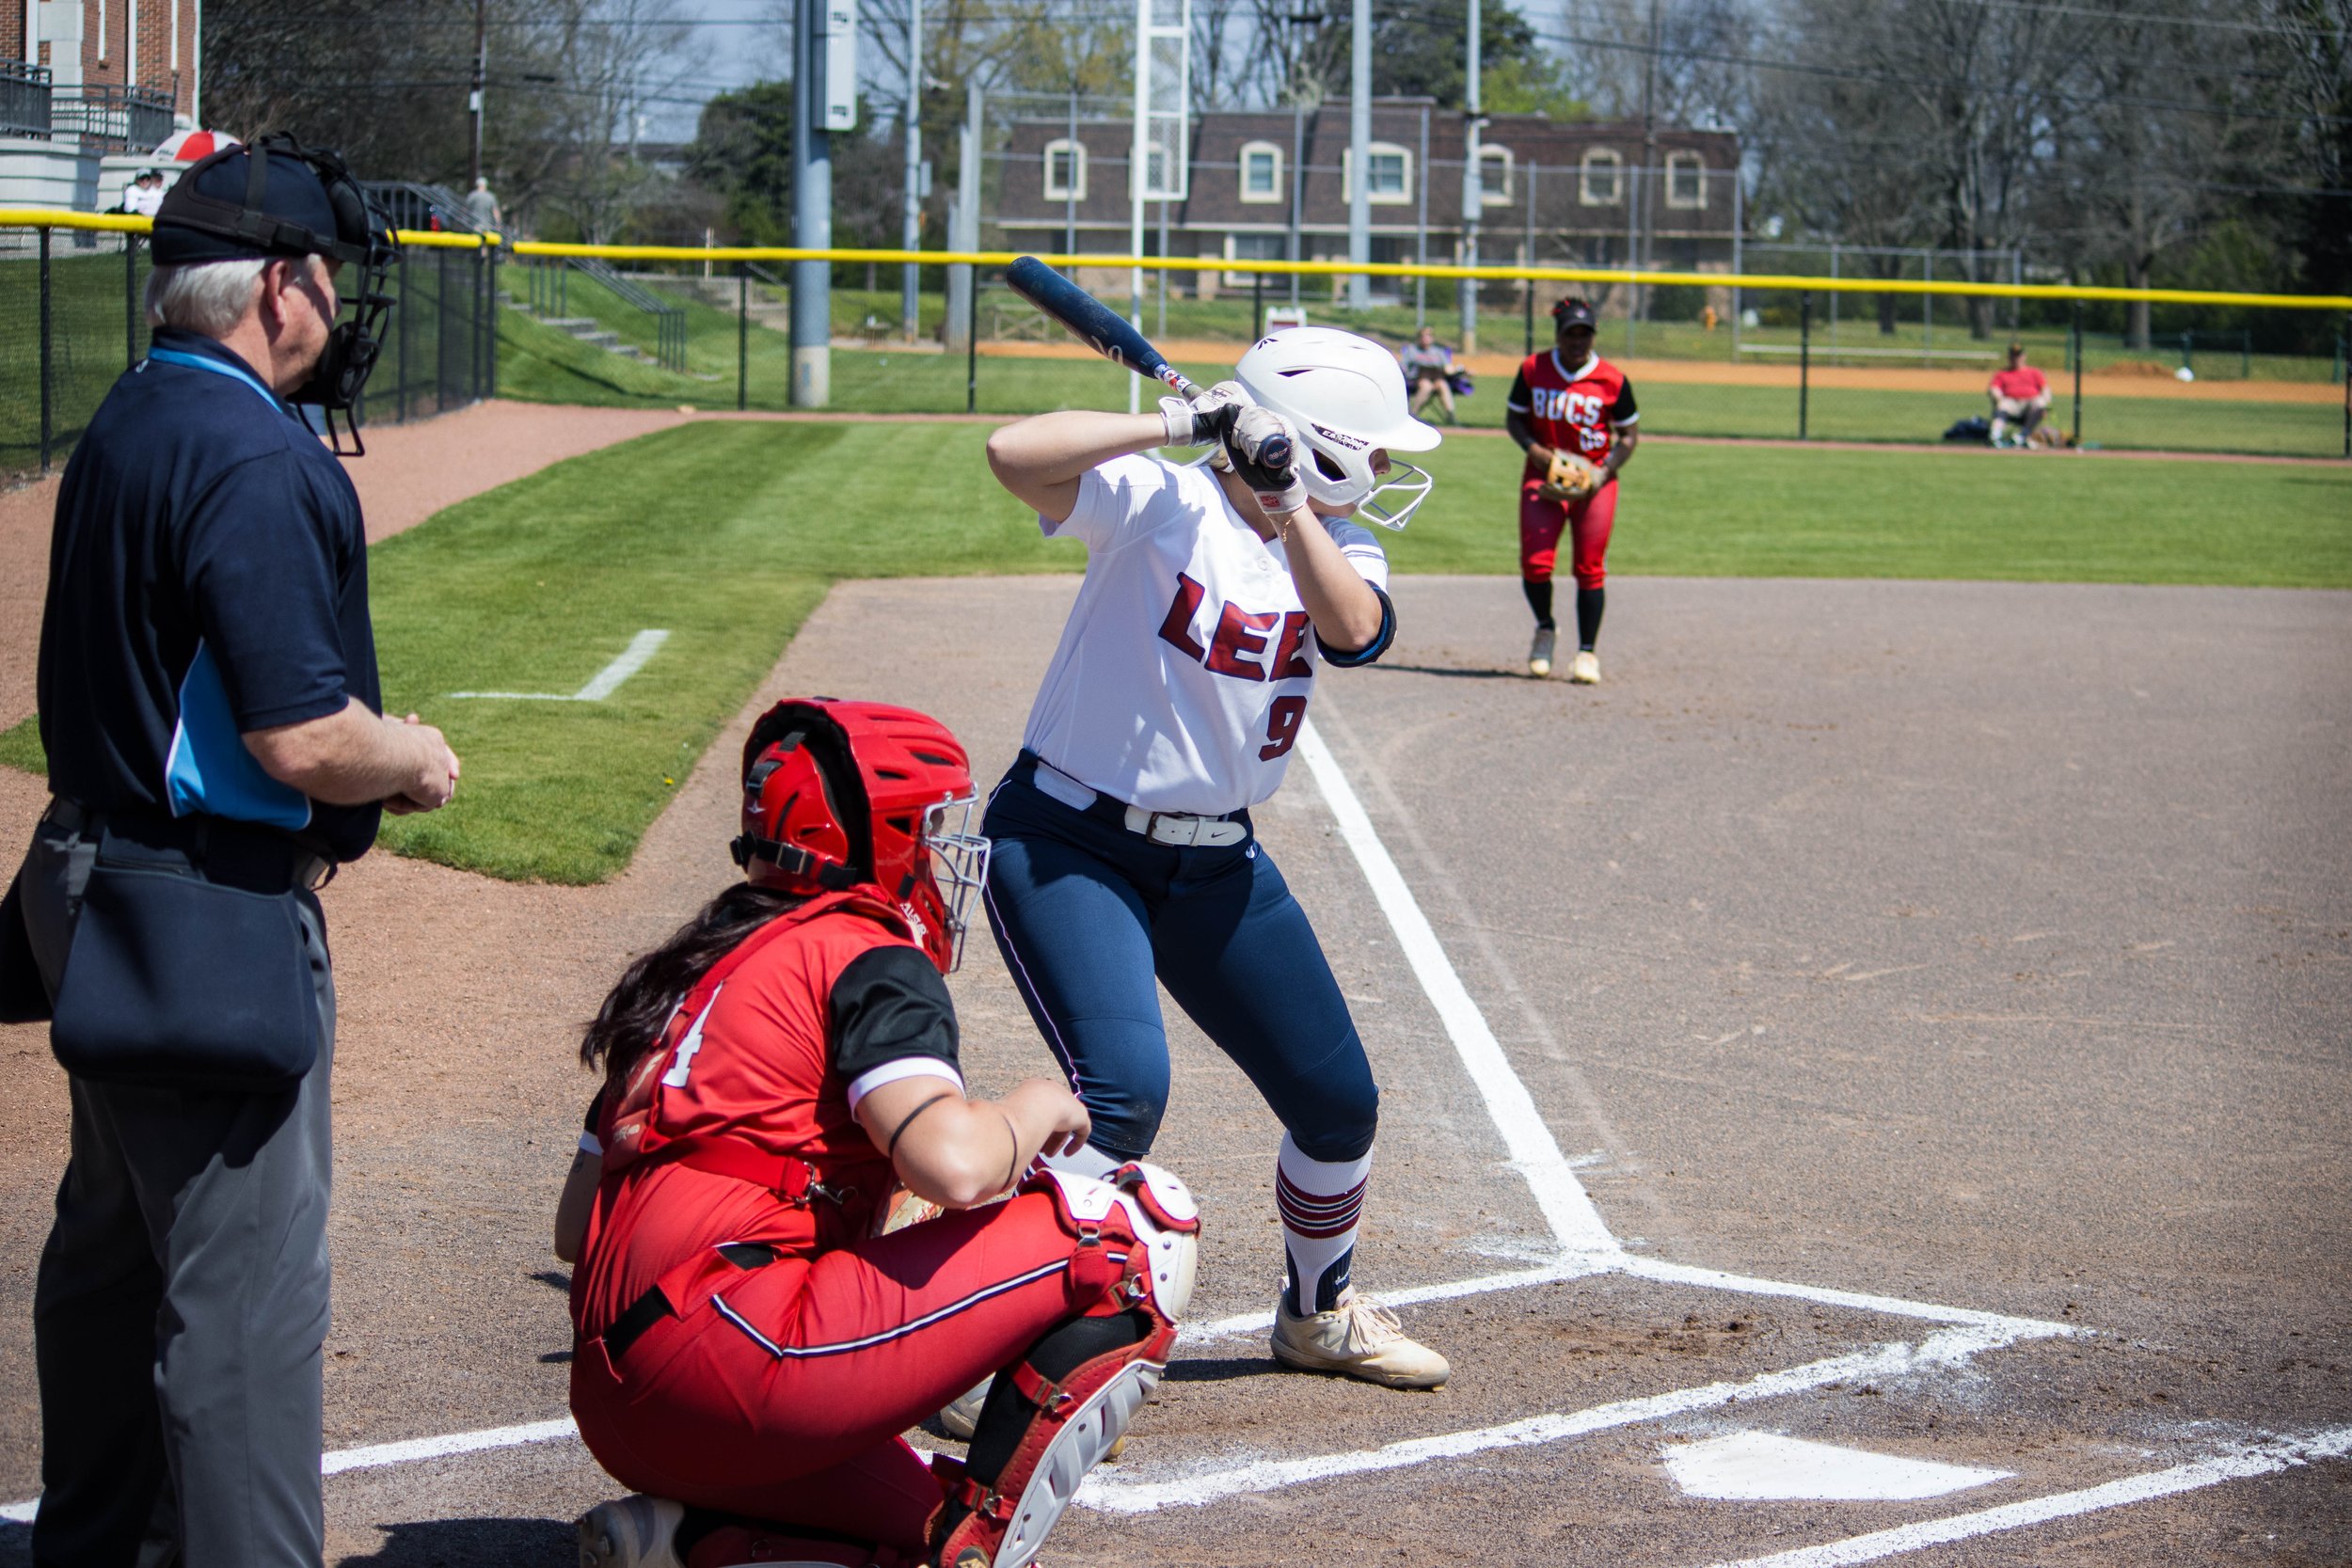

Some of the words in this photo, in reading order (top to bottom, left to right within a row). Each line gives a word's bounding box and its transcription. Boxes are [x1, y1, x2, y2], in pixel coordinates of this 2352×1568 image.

[1532, 388, 1603, 426] BUCS
[1158, 571, 1313, 682] LEE
[1258, 695, 1308, 762] 9
